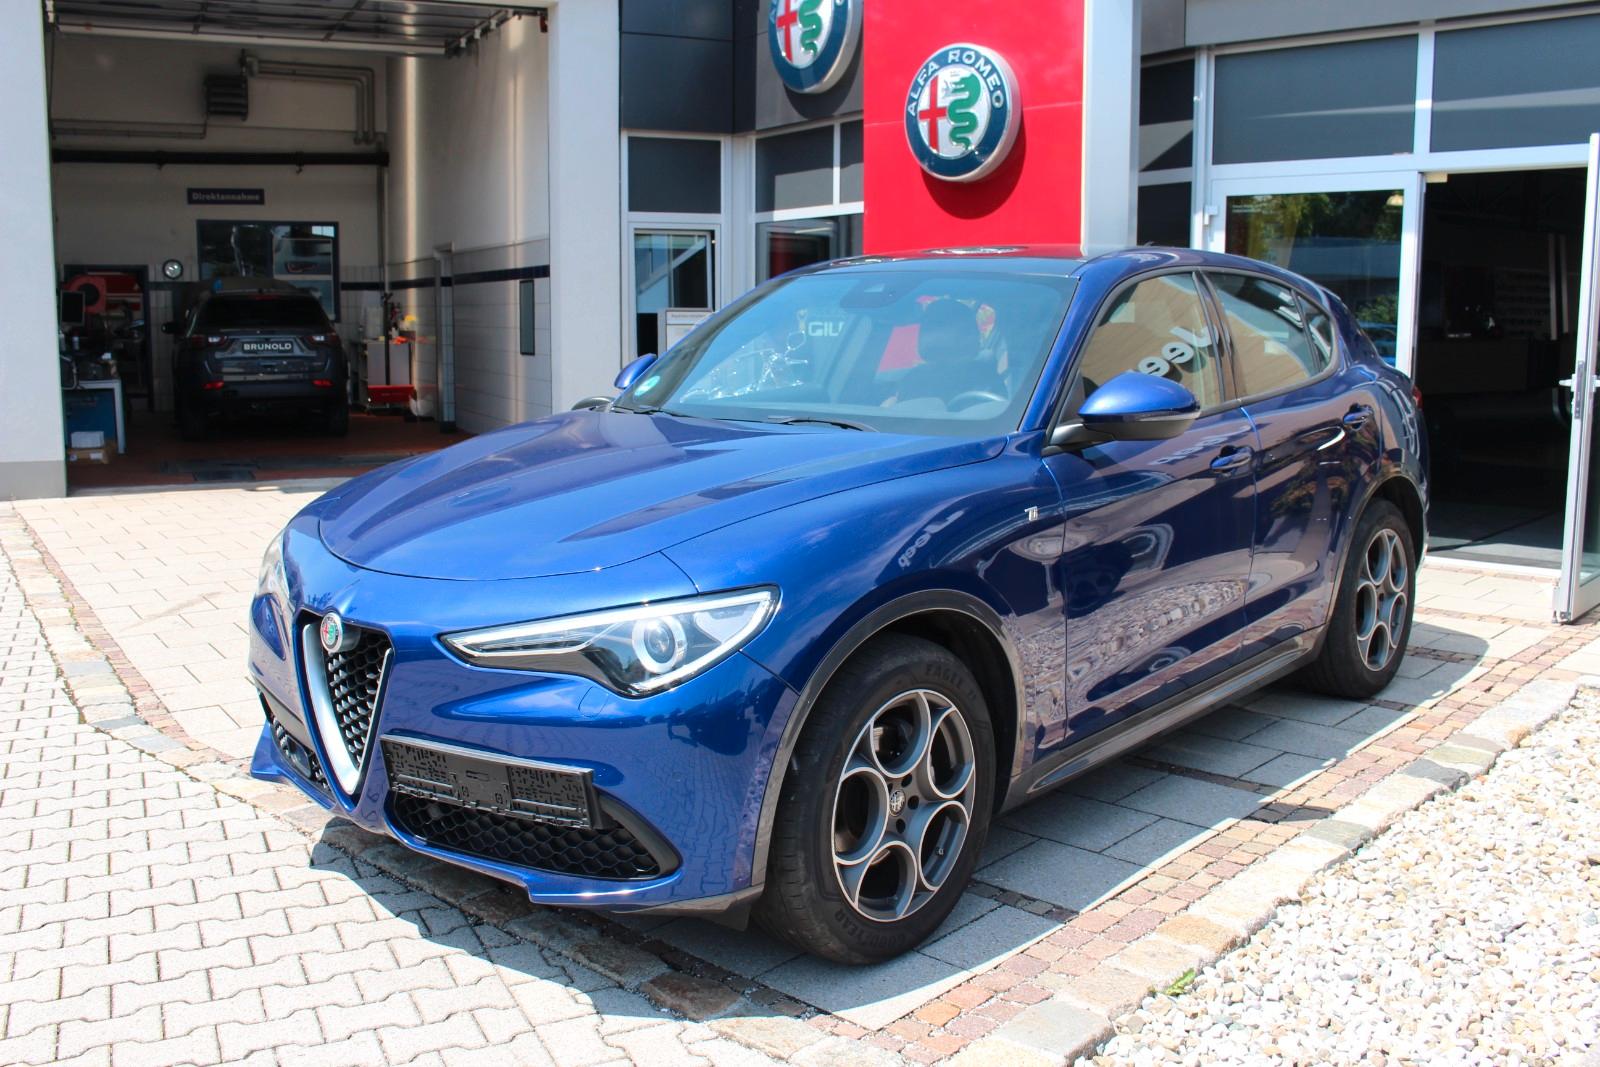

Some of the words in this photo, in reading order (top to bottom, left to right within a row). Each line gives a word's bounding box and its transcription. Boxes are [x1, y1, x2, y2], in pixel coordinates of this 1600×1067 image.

[907, 61, 940, 117] ALFA
[948, 49, 1005, 109] ROMEO
[243, 342, 292, 351] BRUNOLD
